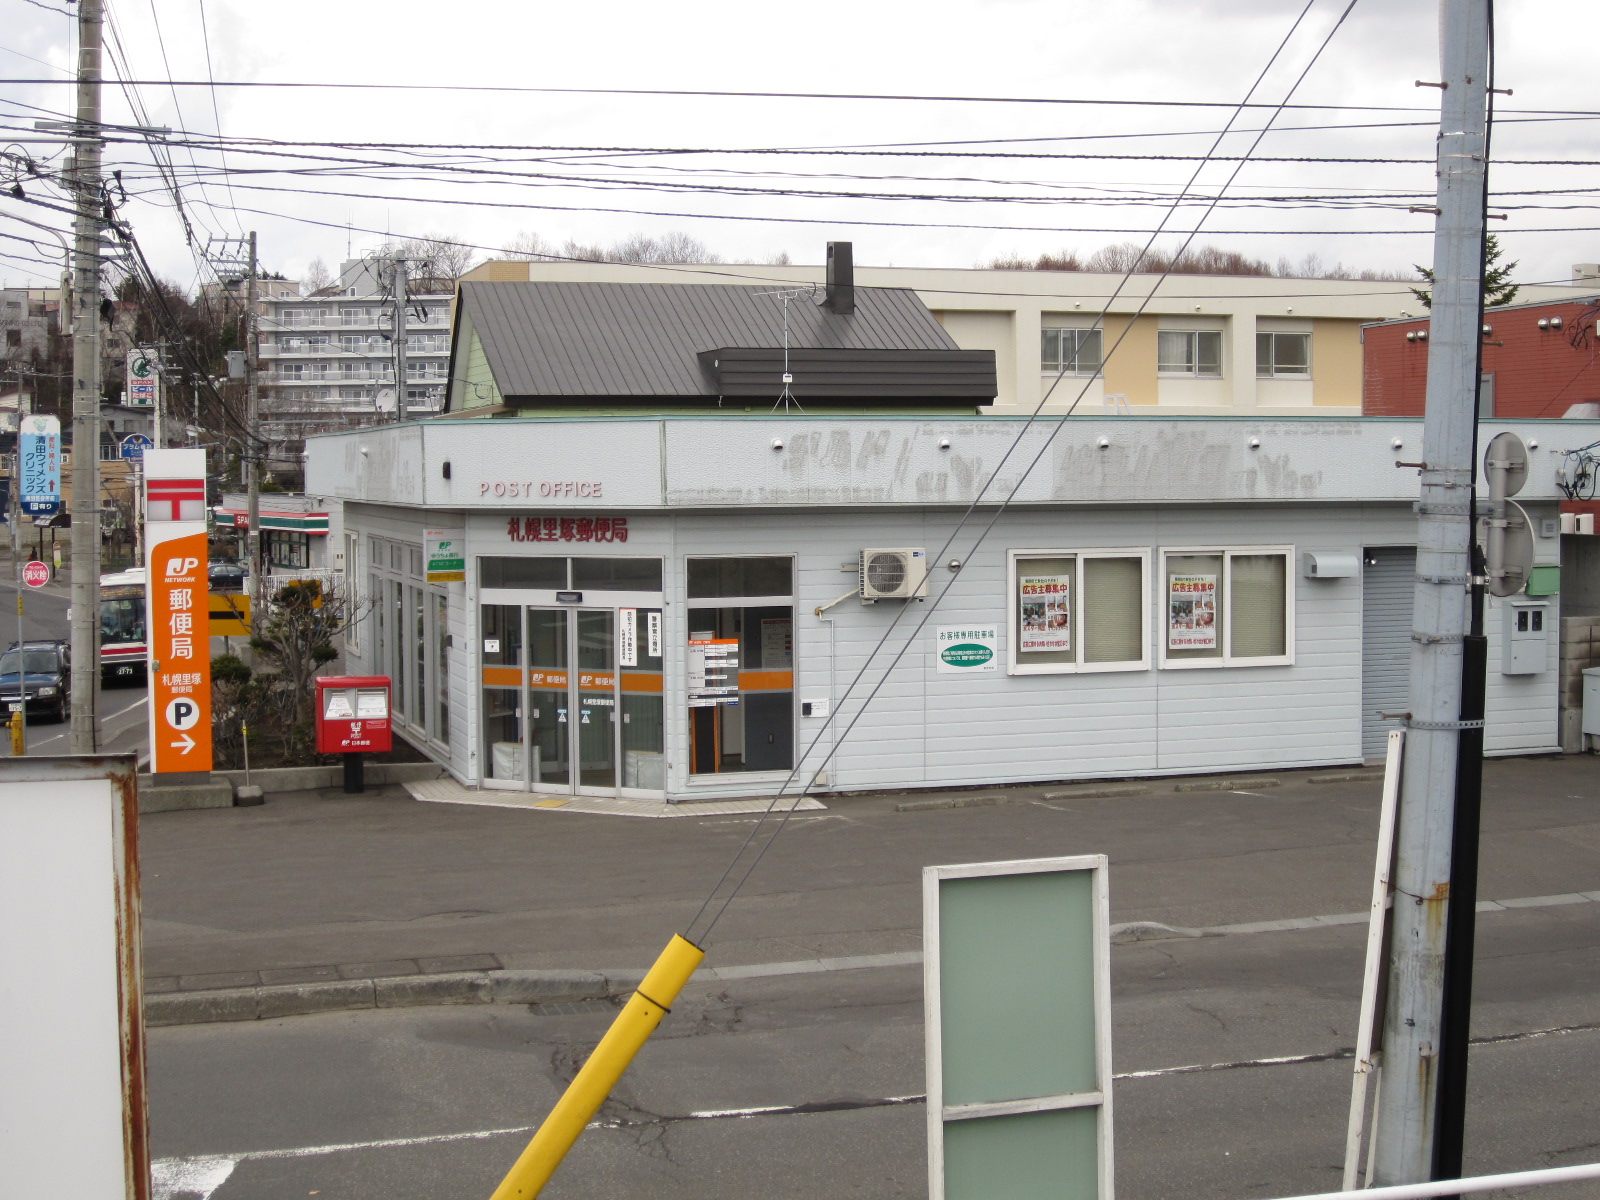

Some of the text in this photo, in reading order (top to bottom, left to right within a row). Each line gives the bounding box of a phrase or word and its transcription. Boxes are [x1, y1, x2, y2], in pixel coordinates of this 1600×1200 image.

[35, 435, 46, 494] 清田ウィメンズ
[25, 452, 36, 494] クリニック
[480, 481, 603, 498] POST OFFICE
[237, 515, 249, 524] SPA
[507, 516, 628, 543] 札幌里塚郵便局
[25, 570, 47, 580] 消火栓
[1023, 583, 1068, 594] 広告主募集中
[1172, 582, 1215, 593] 広告主募集中
[169, 588, 193, 660] 郵便局
[940, 630, 995, 640] お客様専用駐車場
[162, 673, 202, 686] 札幌里塚
[174, 702, 193, 726] P
